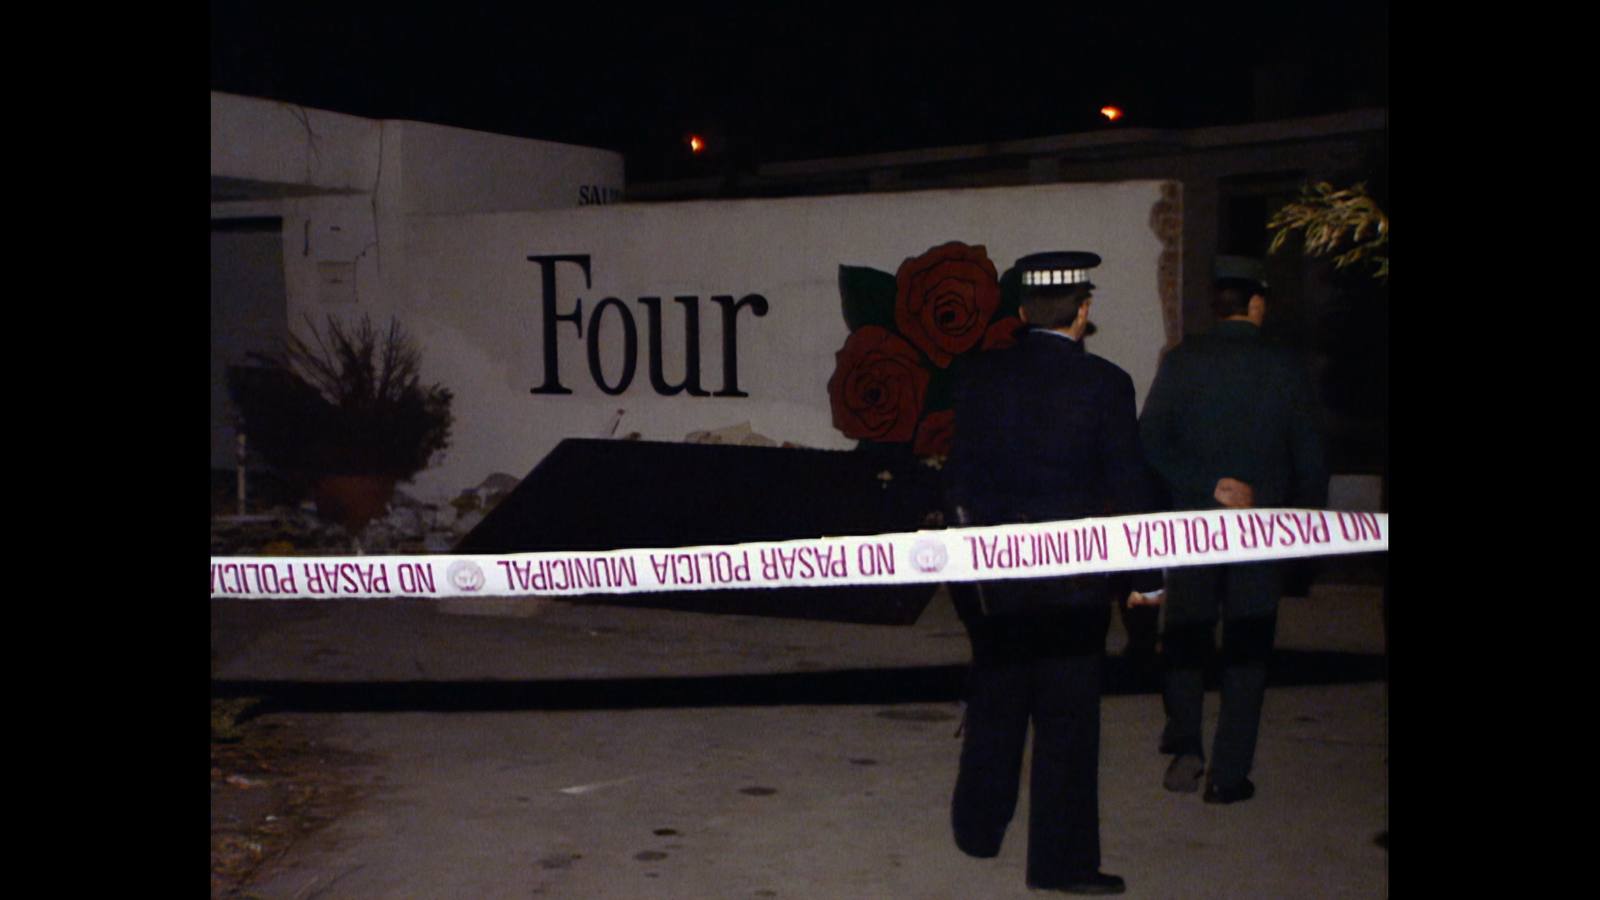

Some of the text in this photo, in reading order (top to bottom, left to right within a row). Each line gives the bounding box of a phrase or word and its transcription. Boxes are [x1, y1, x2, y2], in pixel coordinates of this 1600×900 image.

[527, 254, 769, 398] Four
[963, 511, 1382, 570] NO PASAR POLICIA MUNICIPAL
[303, 564, 391, 594] PASAR
[397, 564, 438, 594] NO
[496, 542, 896, 593] NO PASAR POLICIA MUNICIPAL
